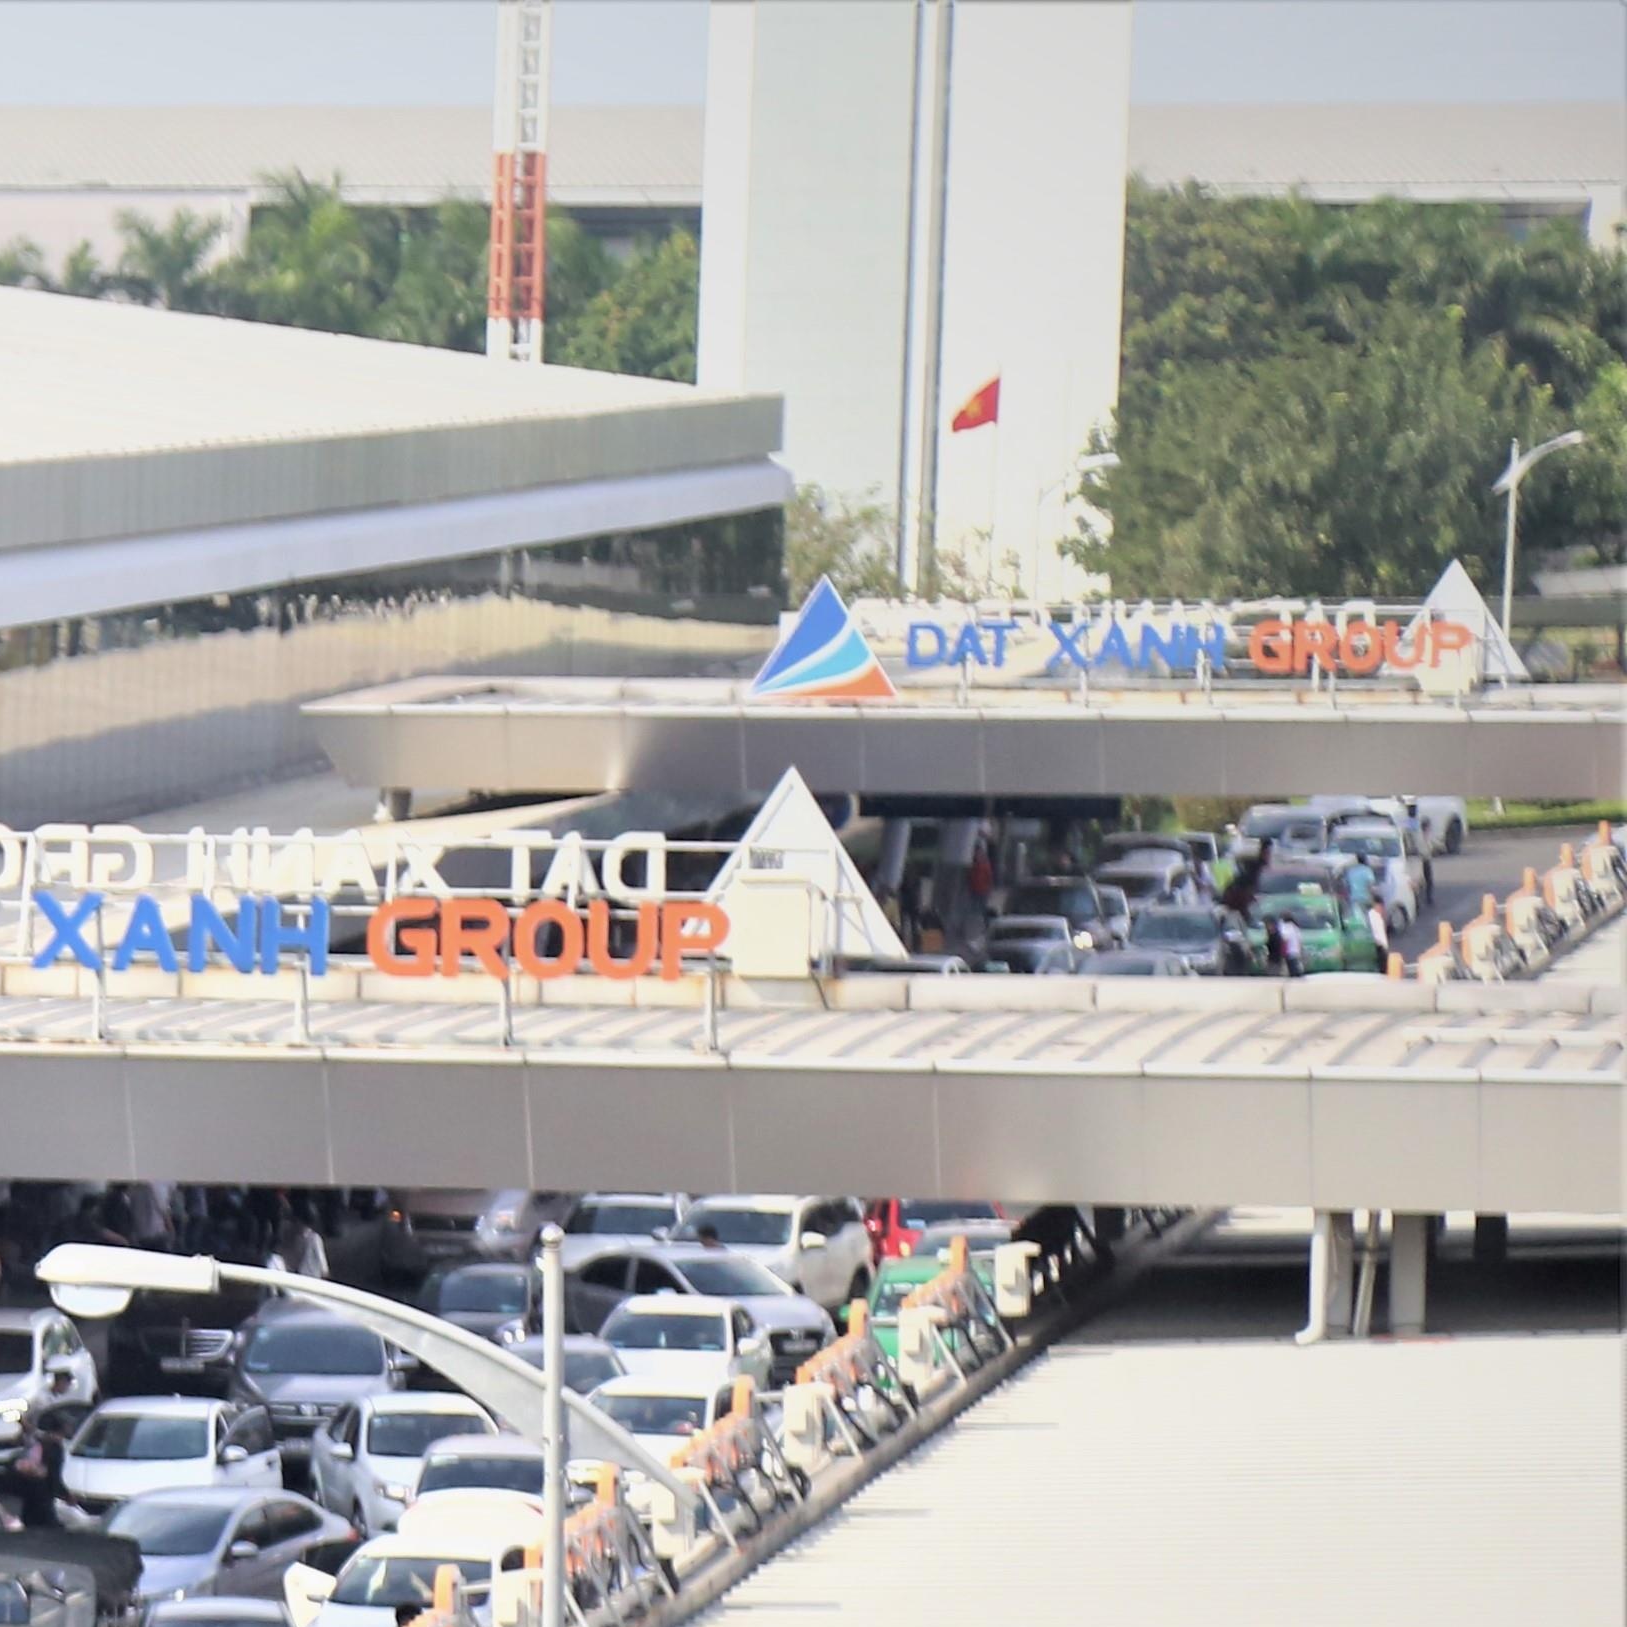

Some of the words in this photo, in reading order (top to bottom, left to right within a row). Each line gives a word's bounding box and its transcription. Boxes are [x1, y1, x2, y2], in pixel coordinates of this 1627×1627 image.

[907, 620, 1018, 668] DAT
[1046, 620, 1225, 672] XANH
[1248, 619, 1473, 674] GROUP
[32, 891, 330, 976] XANH
[367, 898, 730, 982] GROUP
